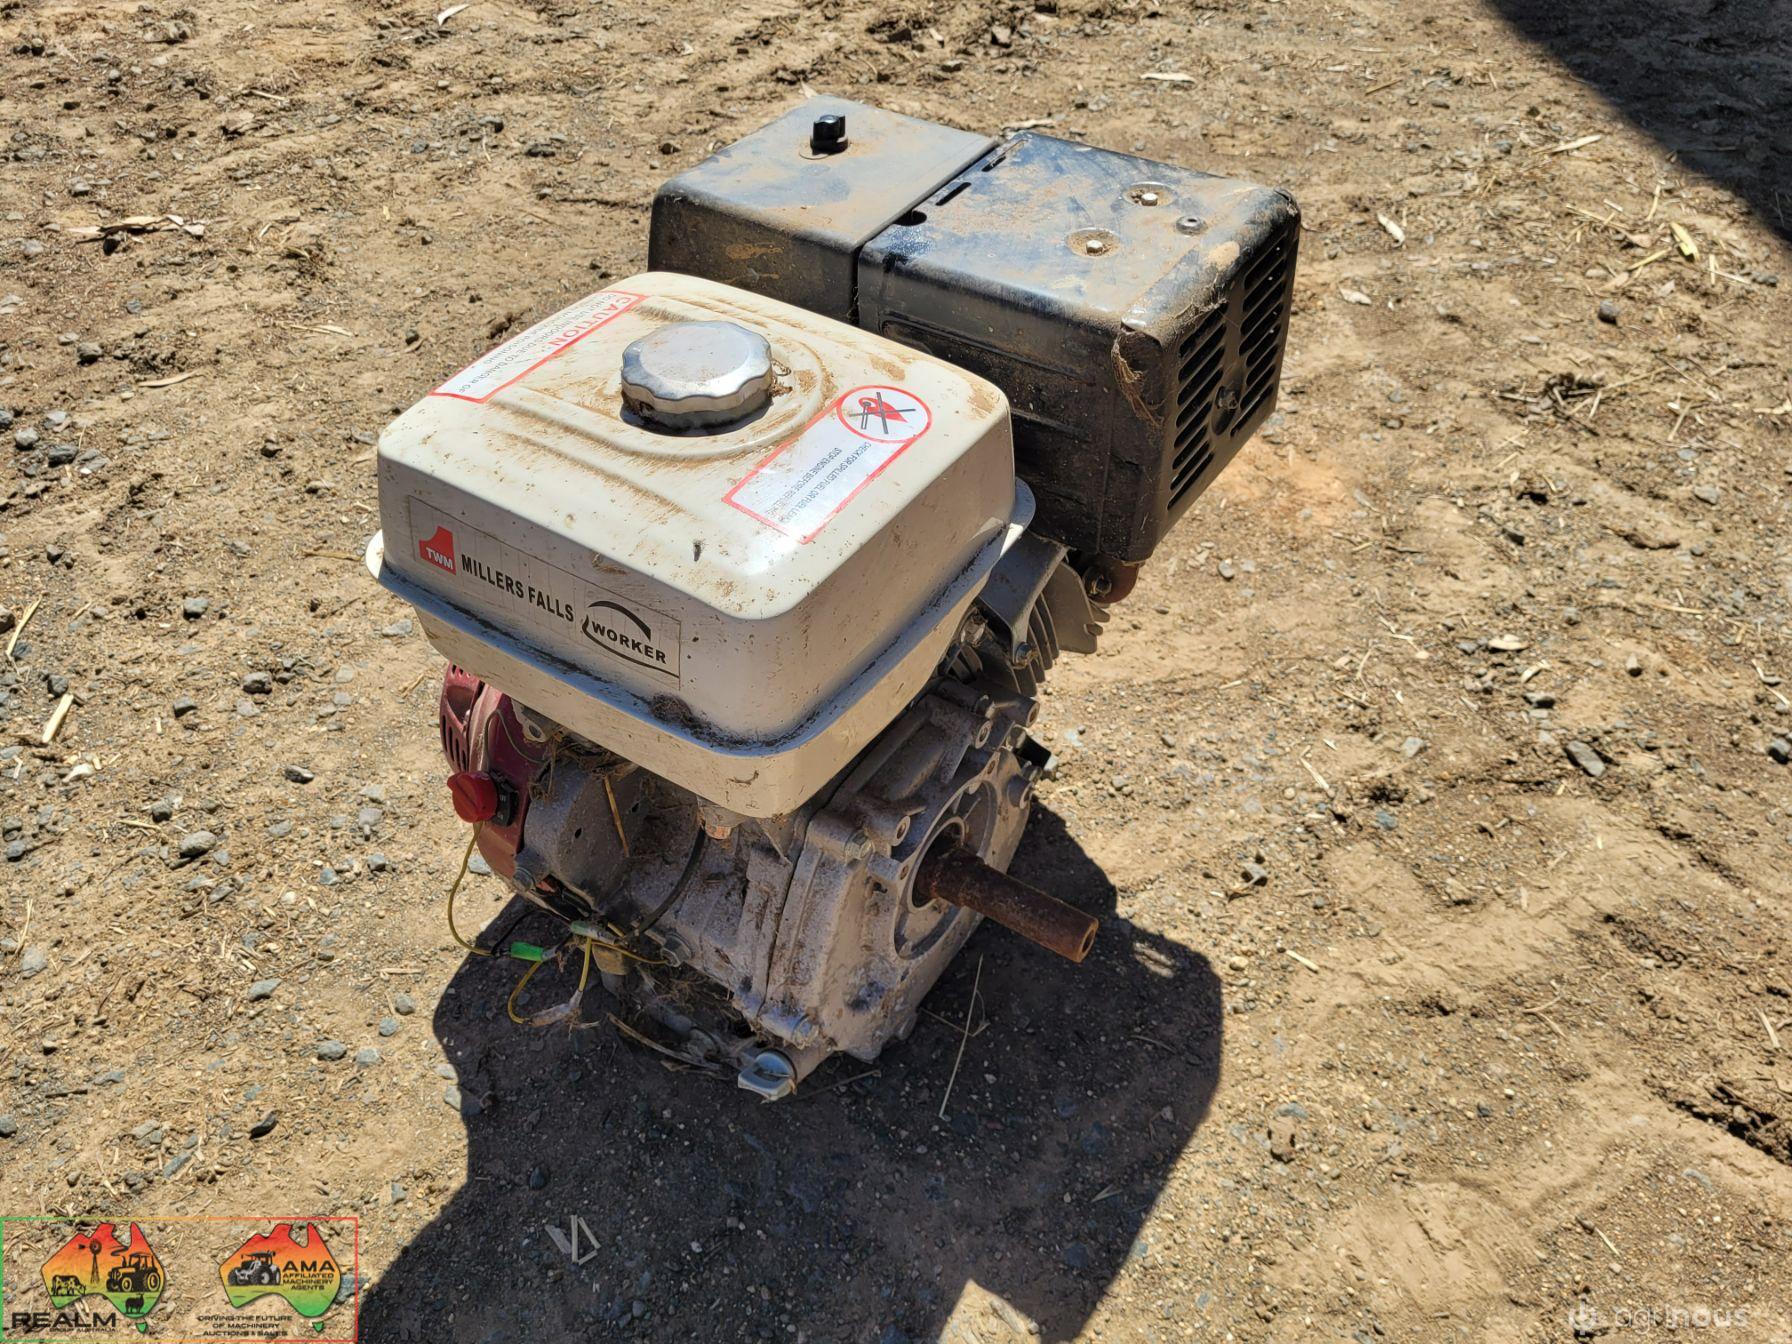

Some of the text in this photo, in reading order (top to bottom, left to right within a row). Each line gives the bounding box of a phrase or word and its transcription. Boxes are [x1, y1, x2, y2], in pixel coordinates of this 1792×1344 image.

[426, 547, 454, 570] TWM
[461, 553, 574, 622] MILLERS FALLS
[592, 620, 667, 664] WORKER
